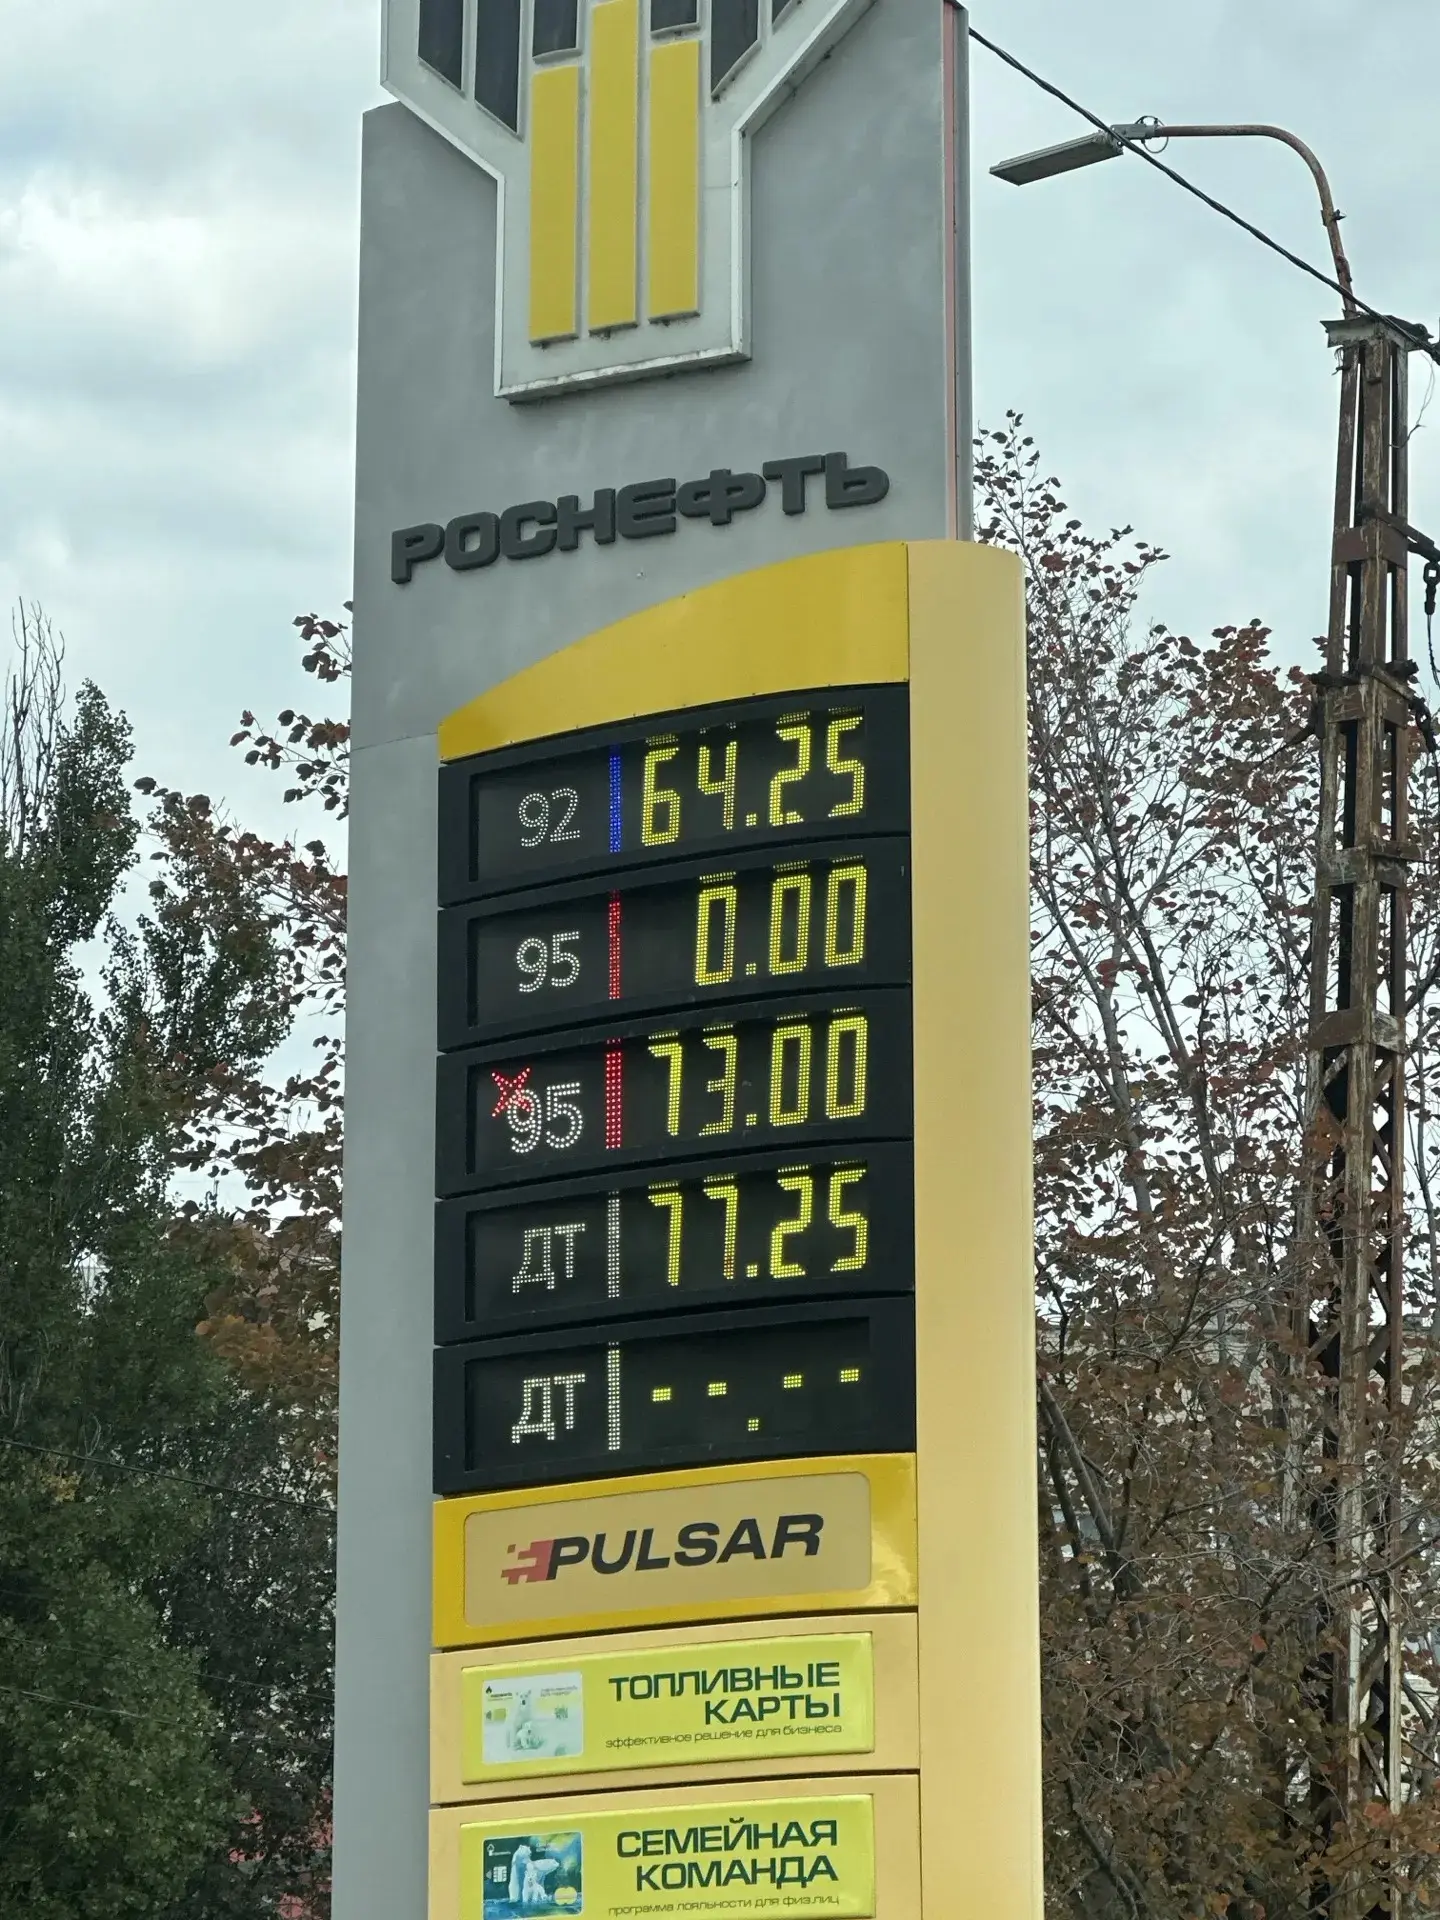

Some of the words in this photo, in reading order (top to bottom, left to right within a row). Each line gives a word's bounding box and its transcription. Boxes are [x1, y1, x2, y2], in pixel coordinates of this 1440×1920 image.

[391, 451, 890, 584] РОСНЕФТЬ
[518, 787, 581, 848] 92
[641, 715, 866, 847] 64.25
[516, 931, 580, 993] 95
[695, 864, 868, 986] 0.00
[648, 1016, 868, 1137] 73.00
[512, 1222, 586, 1293] ДТ
[648, 1168, 868, 1287] 77.25
[512, 1373, 586, 1444] ДТ
[545, 1513, 824, 1581] PULSAR
[608, 1661, 840, 1702] ТОПЛИВНЫЕ
[705, 1692, 840, 1725] КАРТЫ
[605, 1731, 692, 1750] эффективное
[694, 1729, 753, 1744] решение
[755, 1726, 781, 1738] для
[783, 1723, 842, 1736] бизнеса
[616, 1816, 838, 1858] СЕМЕЙНАЯ
[608, 1902, 674, 1918] программа
[676, 1898, 751, 1911] лояльности
[755, 1895, 779, 1909] для
[636, 1855, 839, 1892] КОМАНДА
